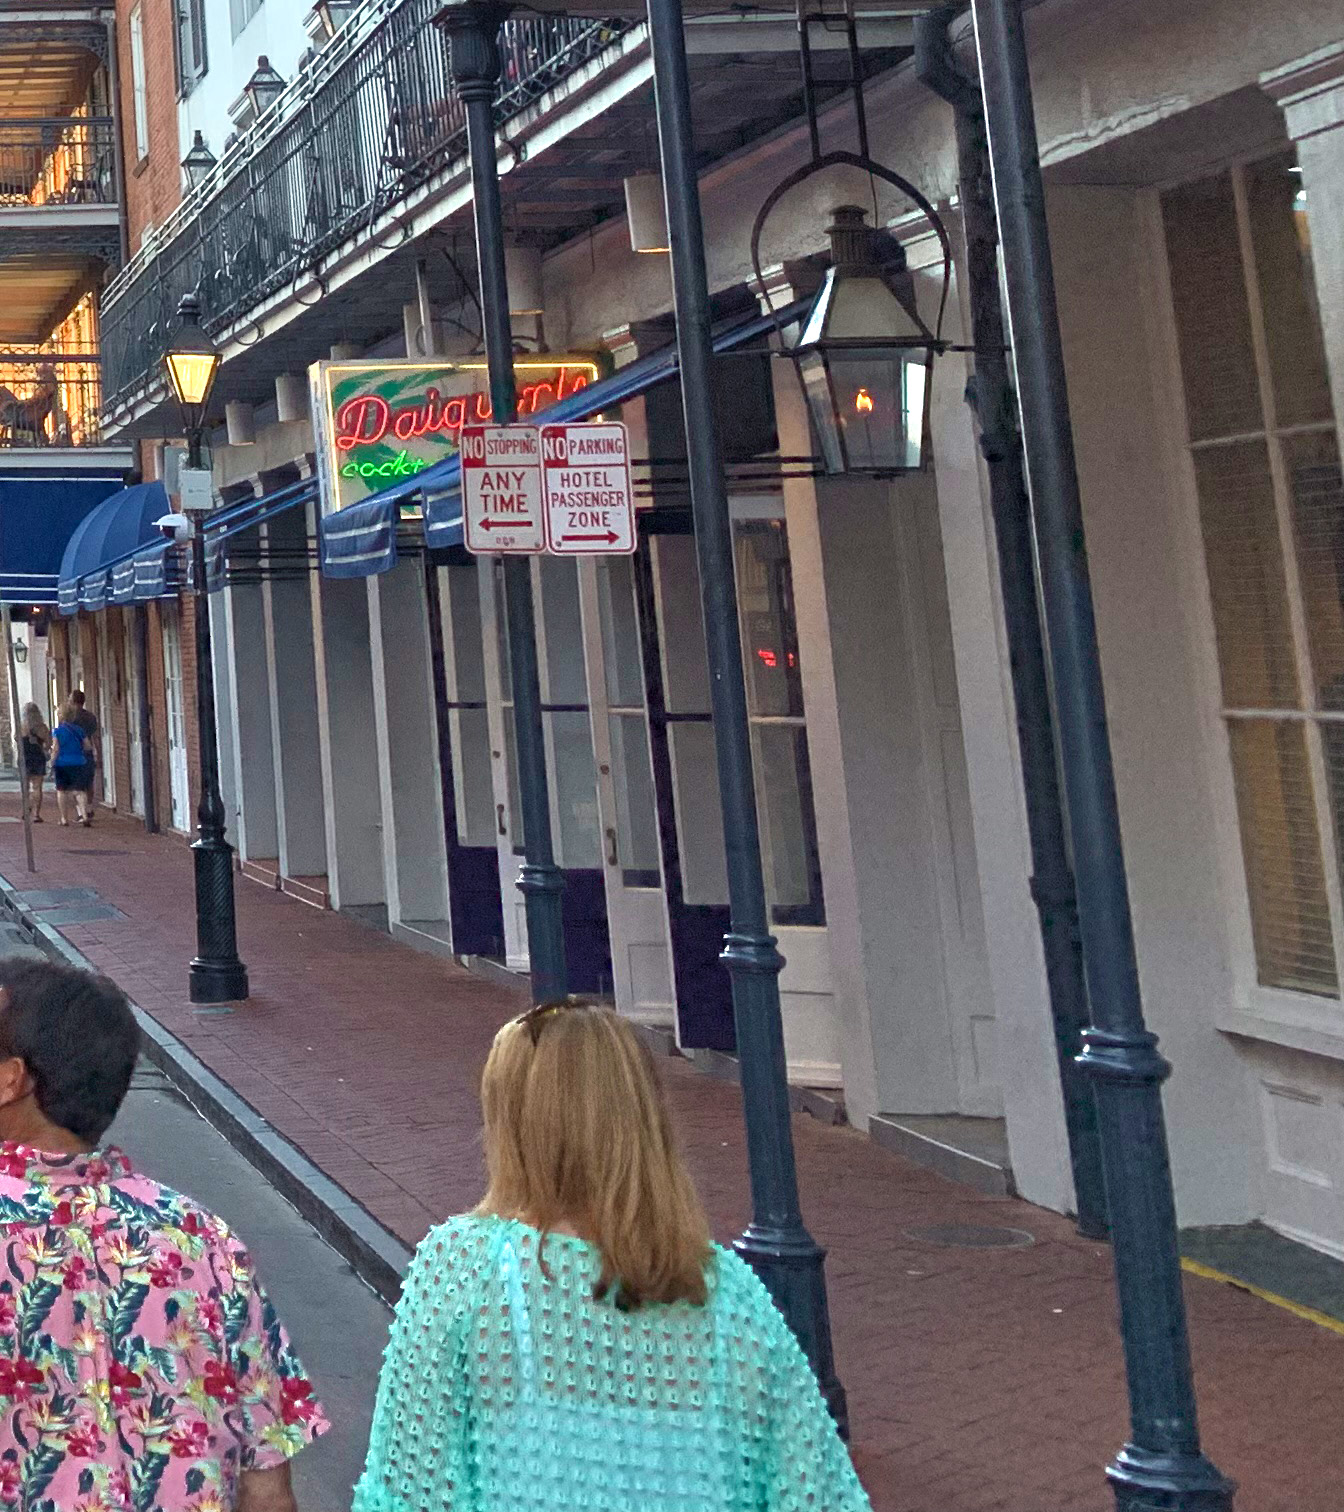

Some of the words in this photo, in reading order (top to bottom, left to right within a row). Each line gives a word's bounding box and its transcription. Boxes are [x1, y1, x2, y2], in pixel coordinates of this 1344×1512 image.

[463, 436, 485, 459] NO
[487, 438, 538, 455] STOPPING
[543, 437, 567, 460] NO
[569, 437, 624, 456] PARKING
[480, 471, 526, 491] ANY
[560, 471, 613, 488] HOTEL
[480, 494, 529, 513] TIME
[551, 491, 625, 508] PASSENGER
[568, 511, 611, 528] ZONE
